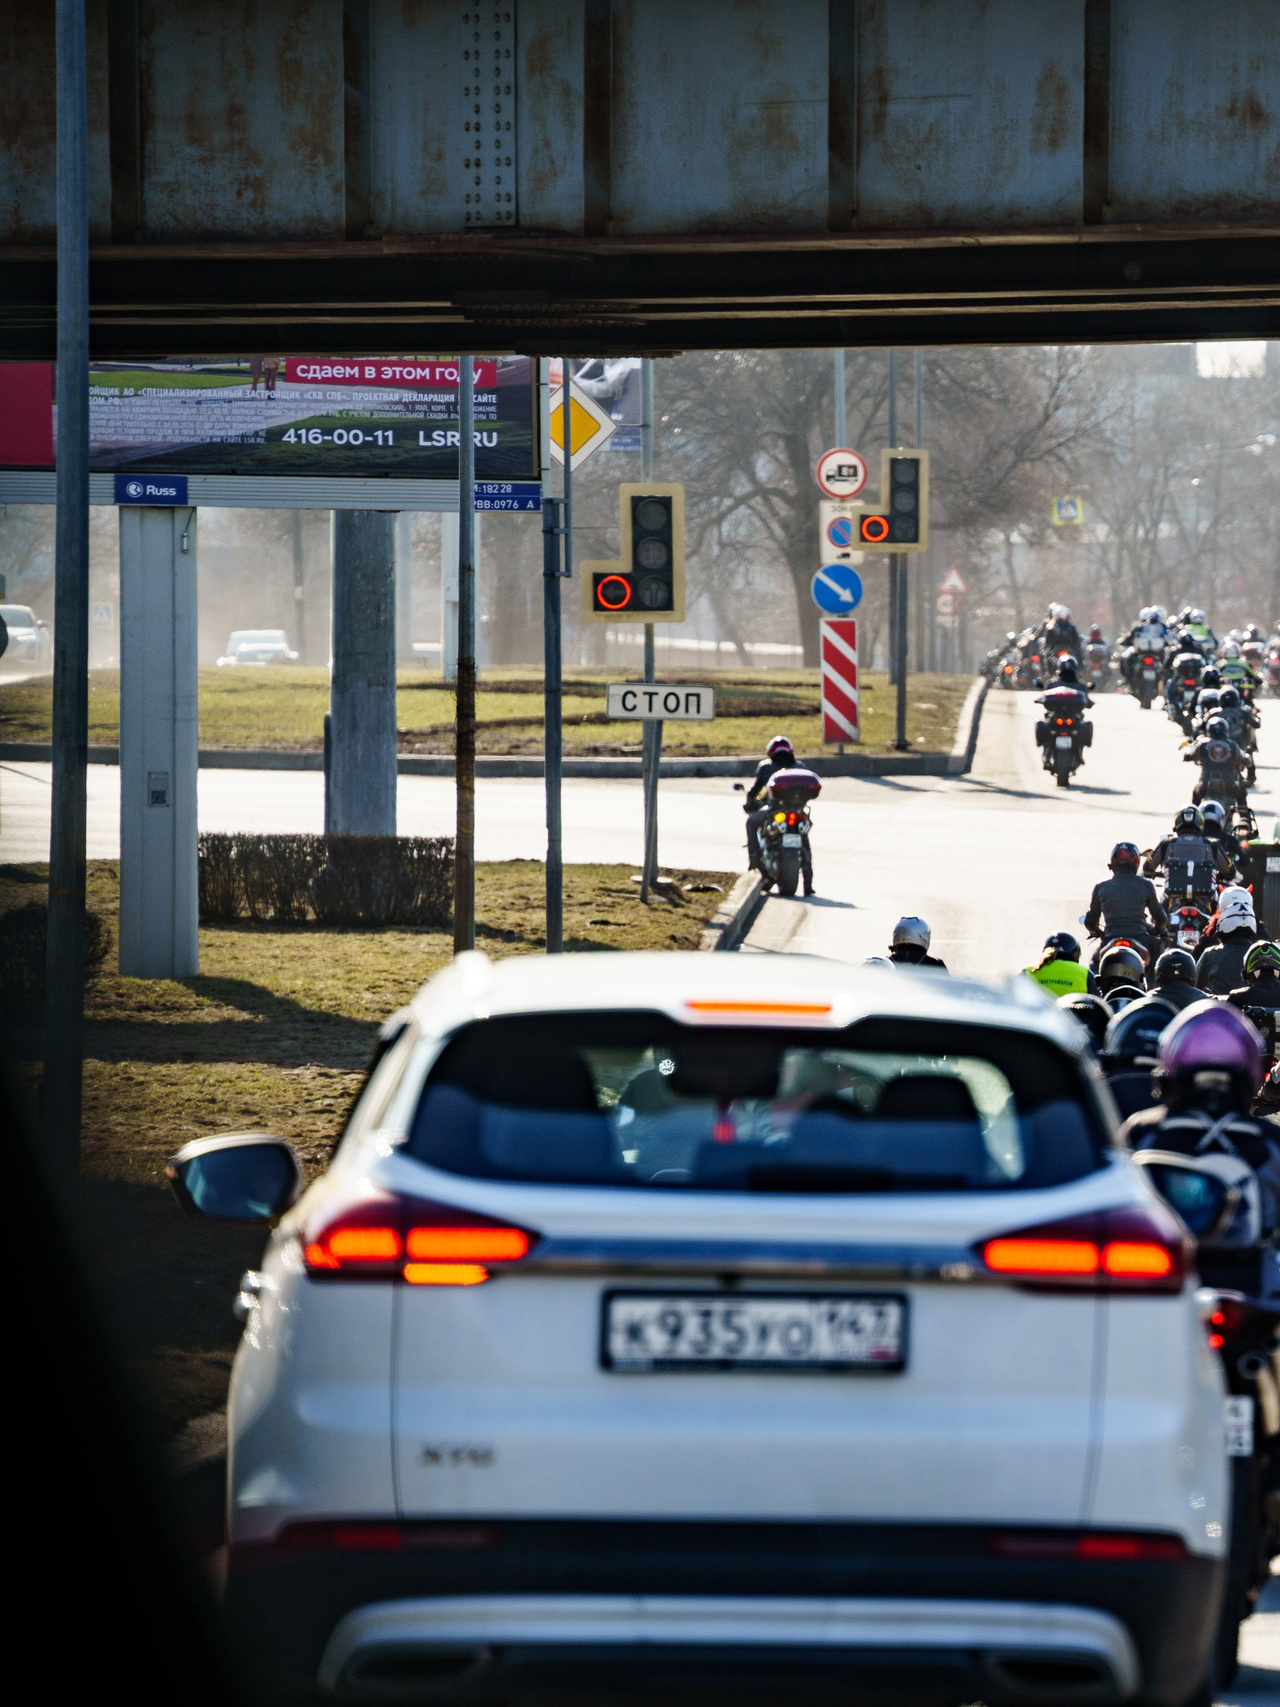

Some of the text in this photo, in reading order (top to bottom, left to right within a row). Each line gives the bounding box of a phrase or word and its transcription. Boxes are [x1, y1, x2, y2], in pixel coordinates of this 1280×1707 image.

[296, 364, 482, 384] сдаем в этом гоу
[246, 389, 300, 400] ЗАСТРОЙЩИК
[352, 392, 399, 401] ПРОЕКТНАЯ
[402, 393, 455, 403] ДЕКЛАРАЦИЯ
[281, 428, 498, 447] 416-00-11 LSRRU
[146, 485, 177, 496] Russ
[621, 690, 701, 714] СТОП
